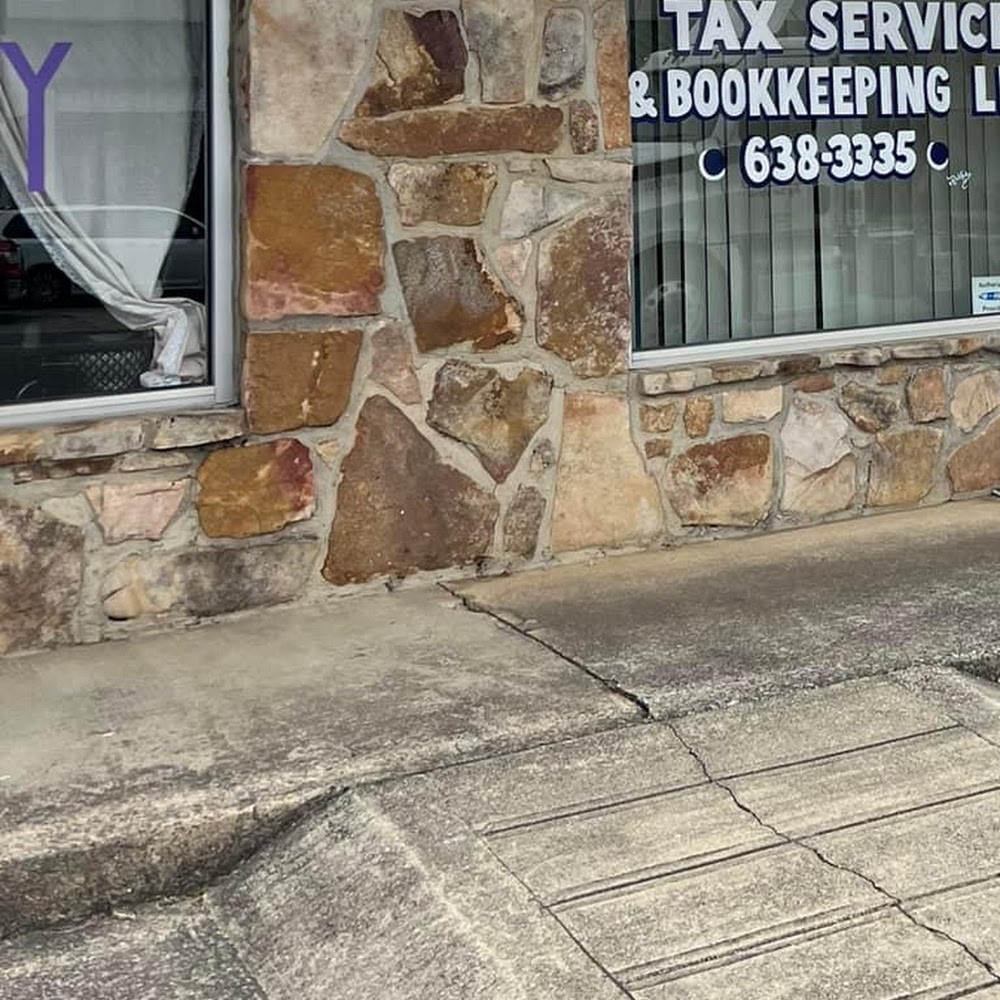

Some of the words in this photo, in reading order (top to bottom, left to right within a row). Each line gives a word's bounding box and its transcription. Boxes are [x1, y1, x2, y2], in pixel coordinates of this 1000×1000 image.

[628, 69, 659, 119] &
[665, 65, 952, 121] BOOKKEEPING
[741, 130, 918, 186] 638-3335
